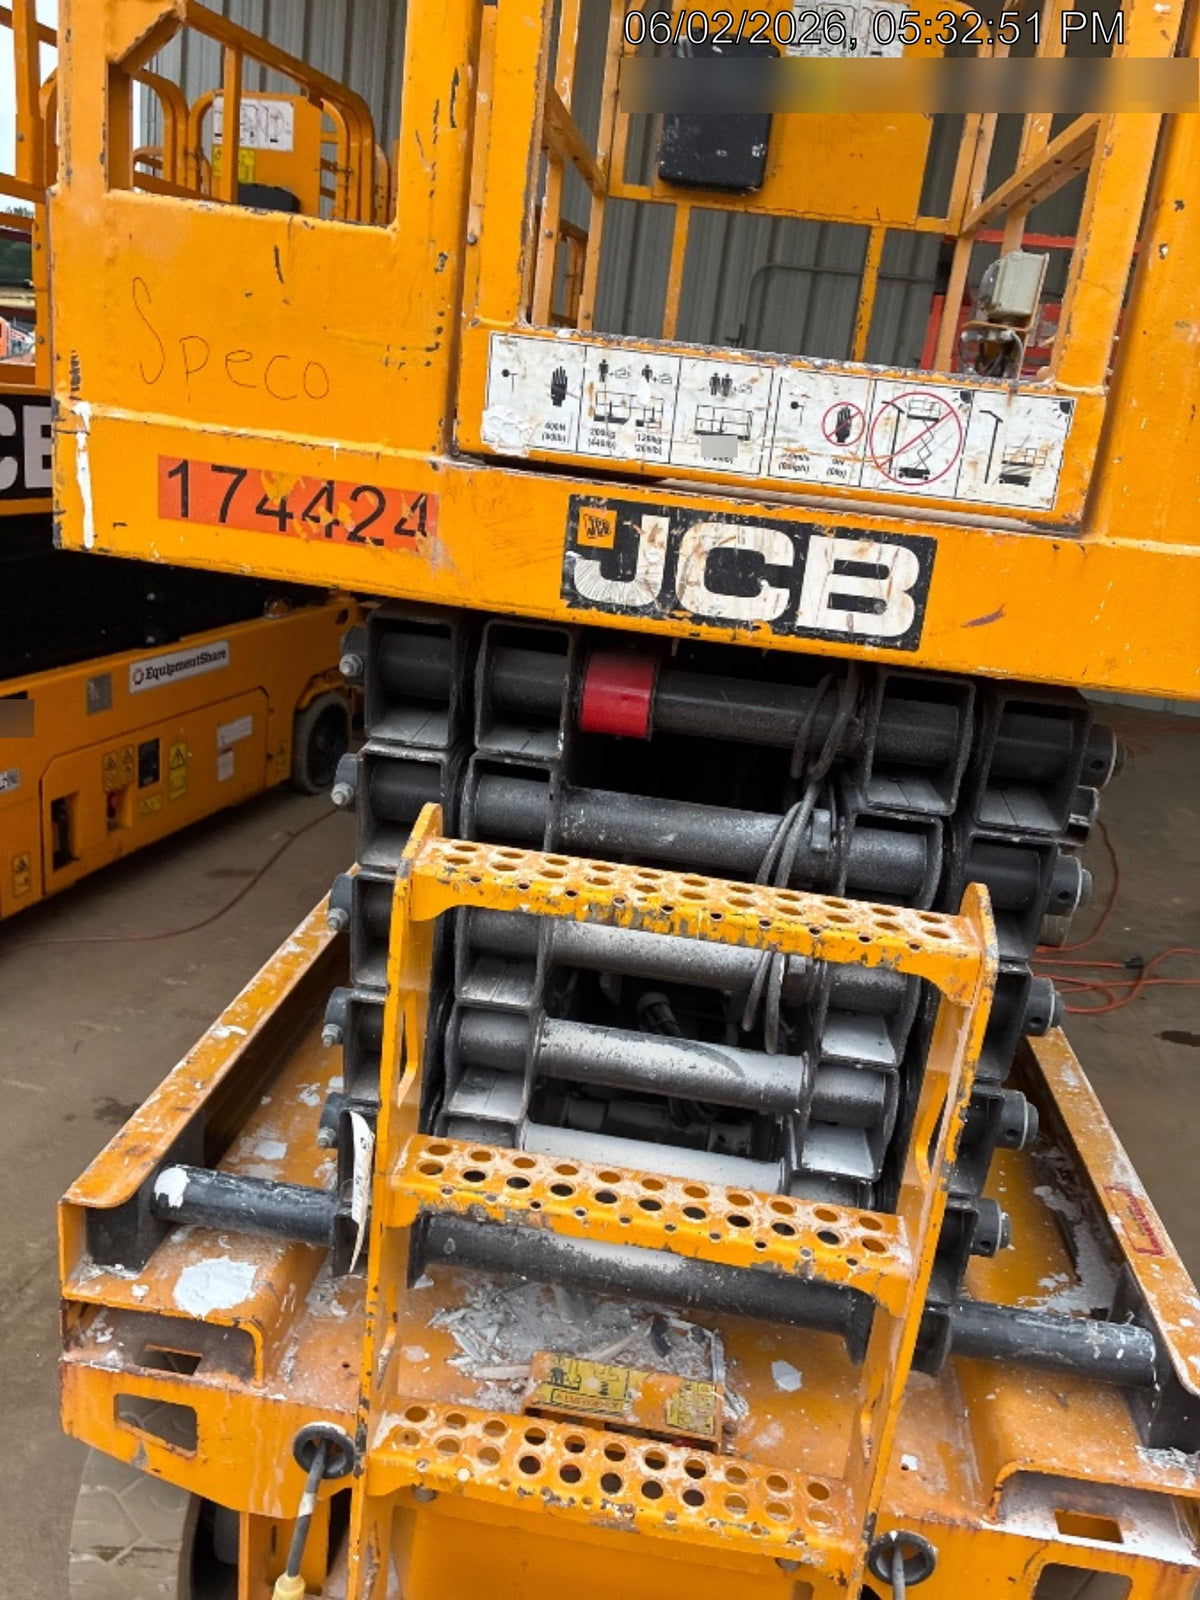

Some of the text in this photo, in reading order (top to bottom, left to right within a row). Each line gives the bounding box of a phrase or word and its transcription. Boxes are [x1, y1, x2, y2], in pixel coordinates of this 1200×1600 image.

[132, 276, 330, 403] Speco
[167, 459, 428, 547] 174424
[573, 514, 921, 638] JCB
[145, 649, 227, 681] EquipmentShare
